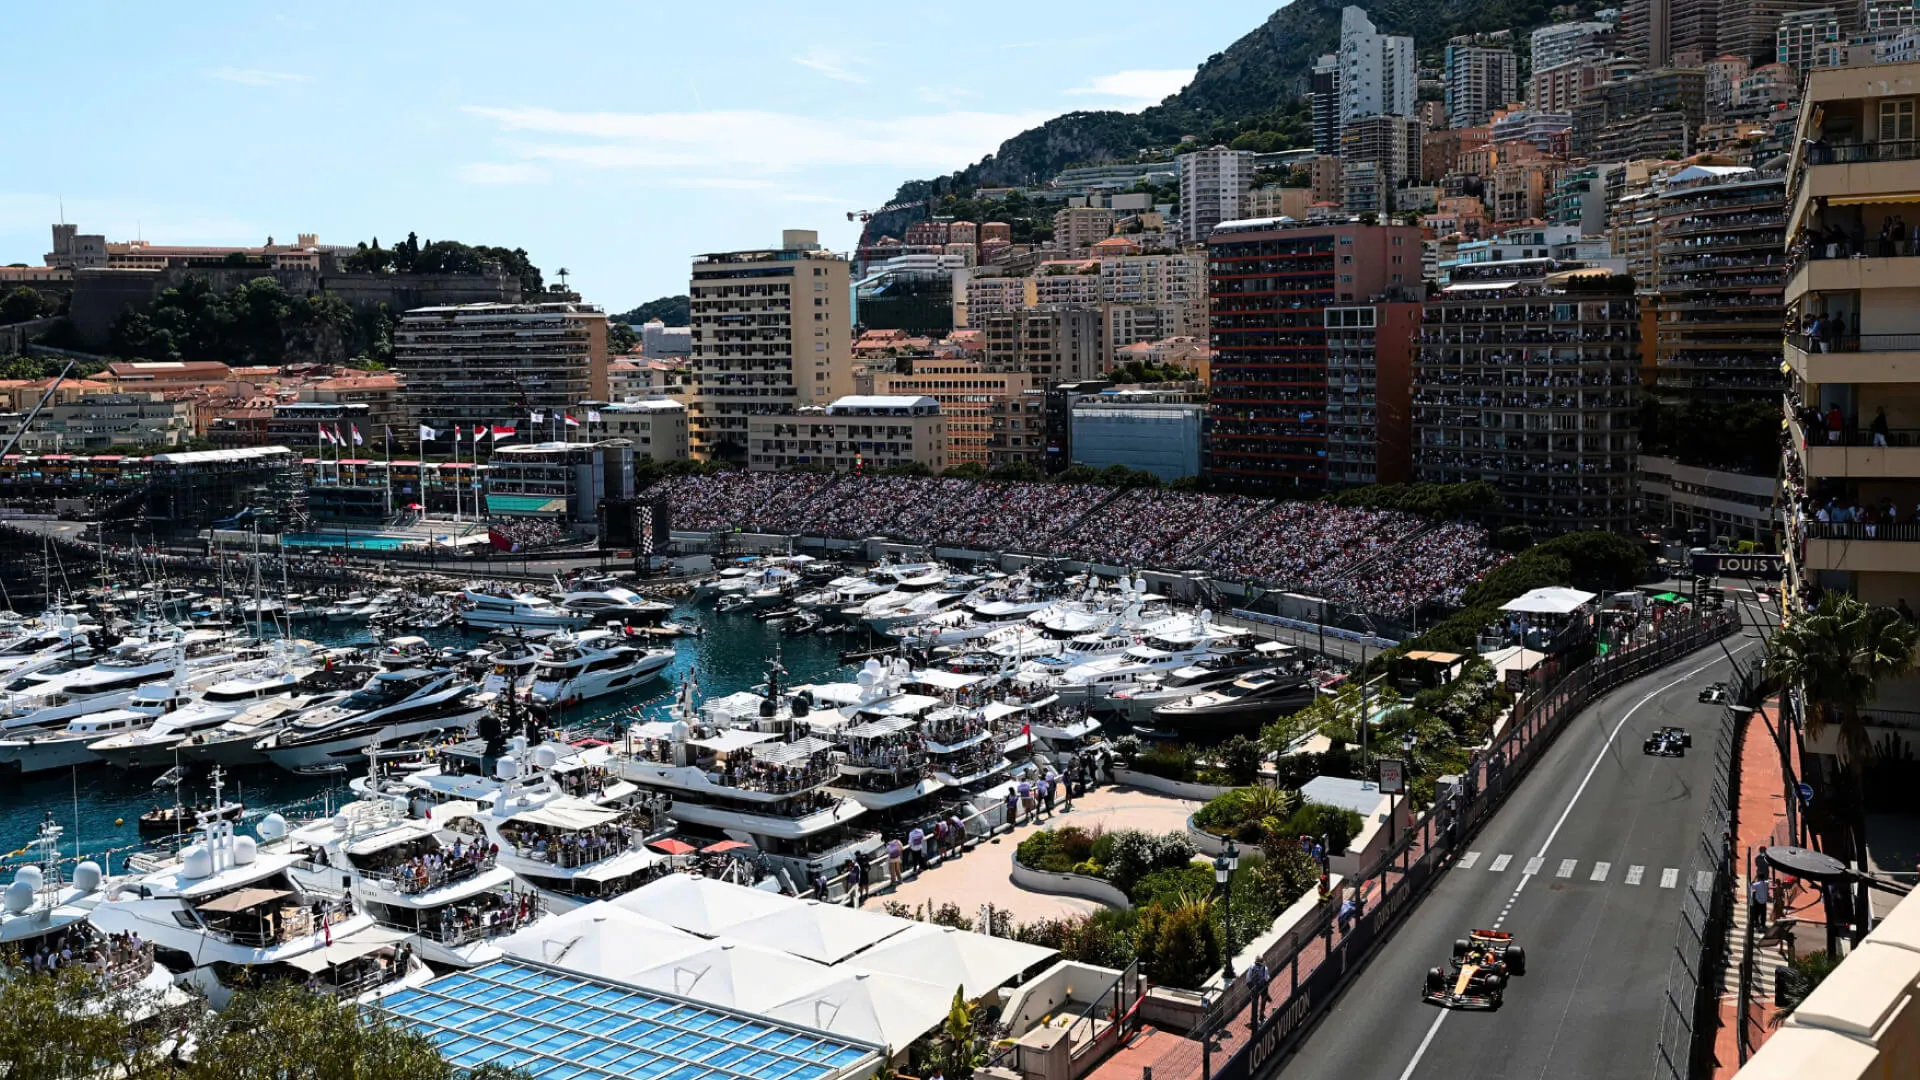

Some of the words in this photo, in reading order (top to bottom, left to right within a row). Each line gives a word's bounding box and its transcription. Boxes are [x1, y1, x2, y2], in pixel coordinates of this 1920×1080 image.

[1719, 558, 1768, 572] LOUIS
[1249, 1025, 1276, 1076] LOUIS
[1276, 986, 1311, 1042] VUITTON
